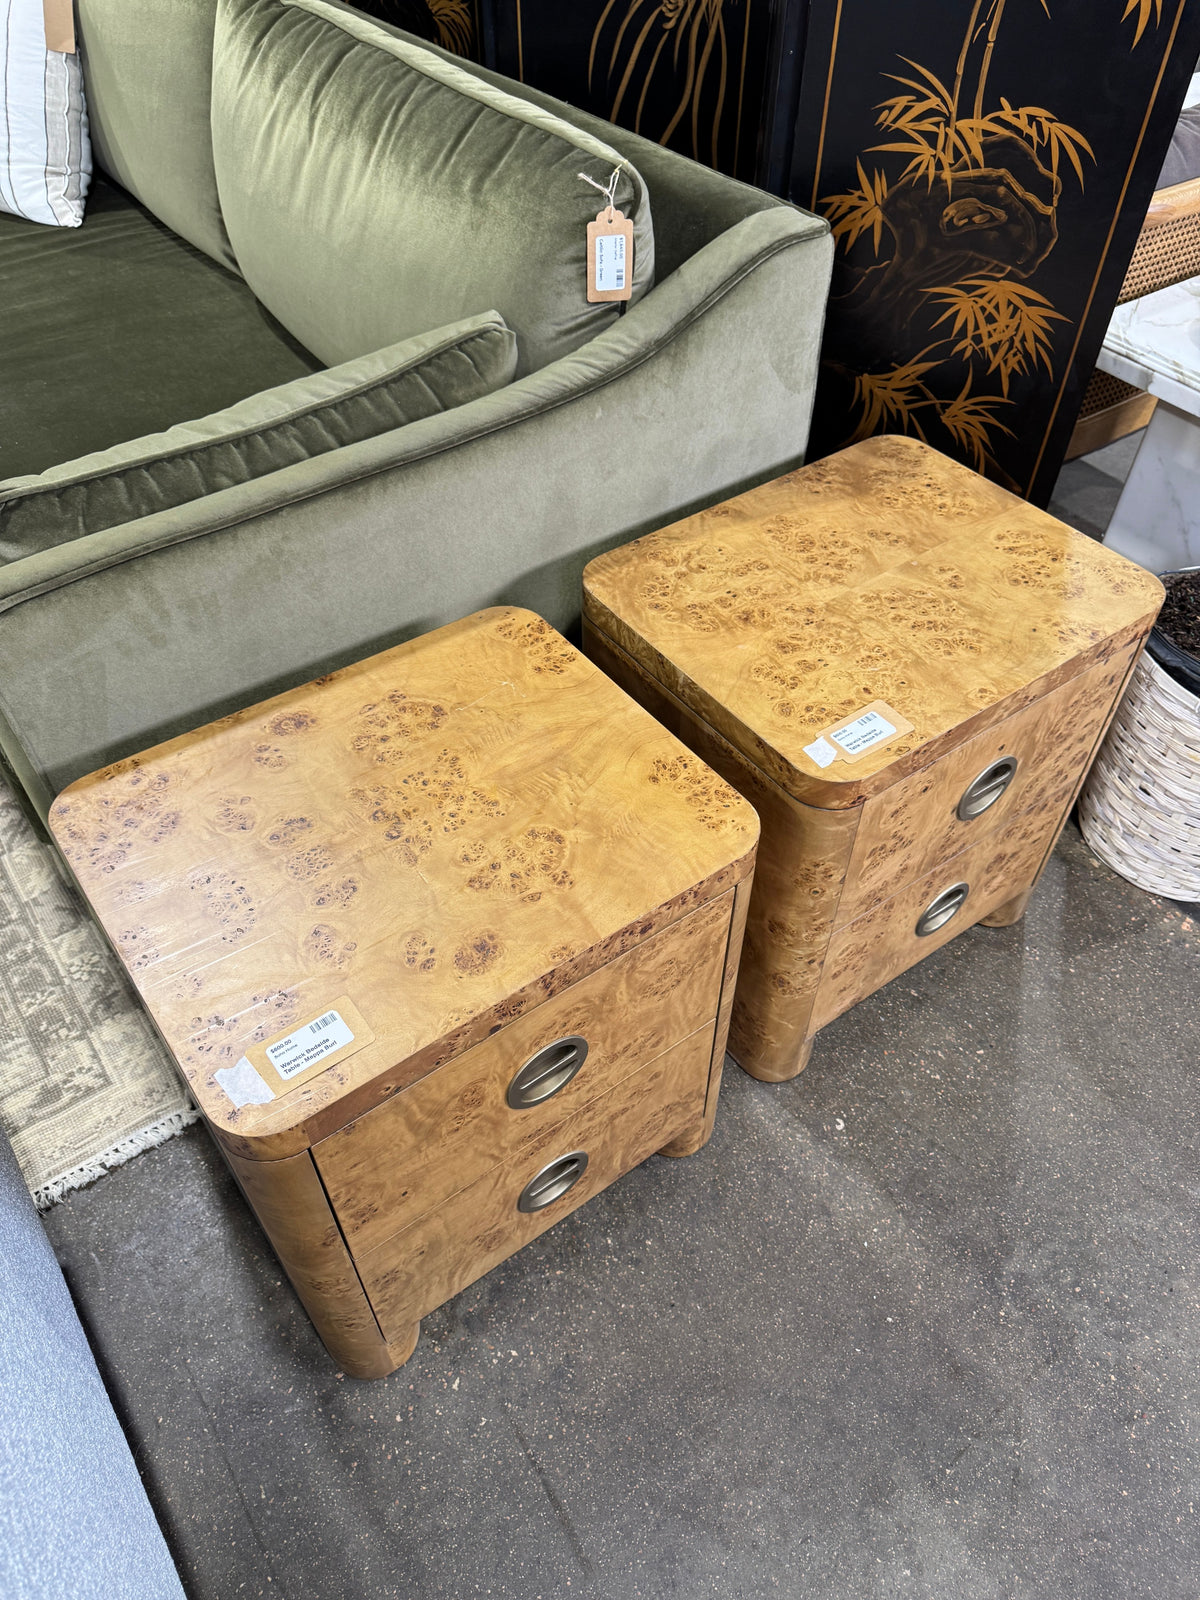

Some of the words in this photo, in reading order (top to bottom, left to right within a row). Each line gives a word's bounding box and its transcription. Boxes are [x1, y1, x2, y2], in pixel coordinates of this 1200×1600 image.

[280, 1052, 305, 1069] Warwick
[305, 1038, 330, 1054] Bedside
[284, 1061, 301, 1074] Table
[324, 1040, 338, 1051] Burl
